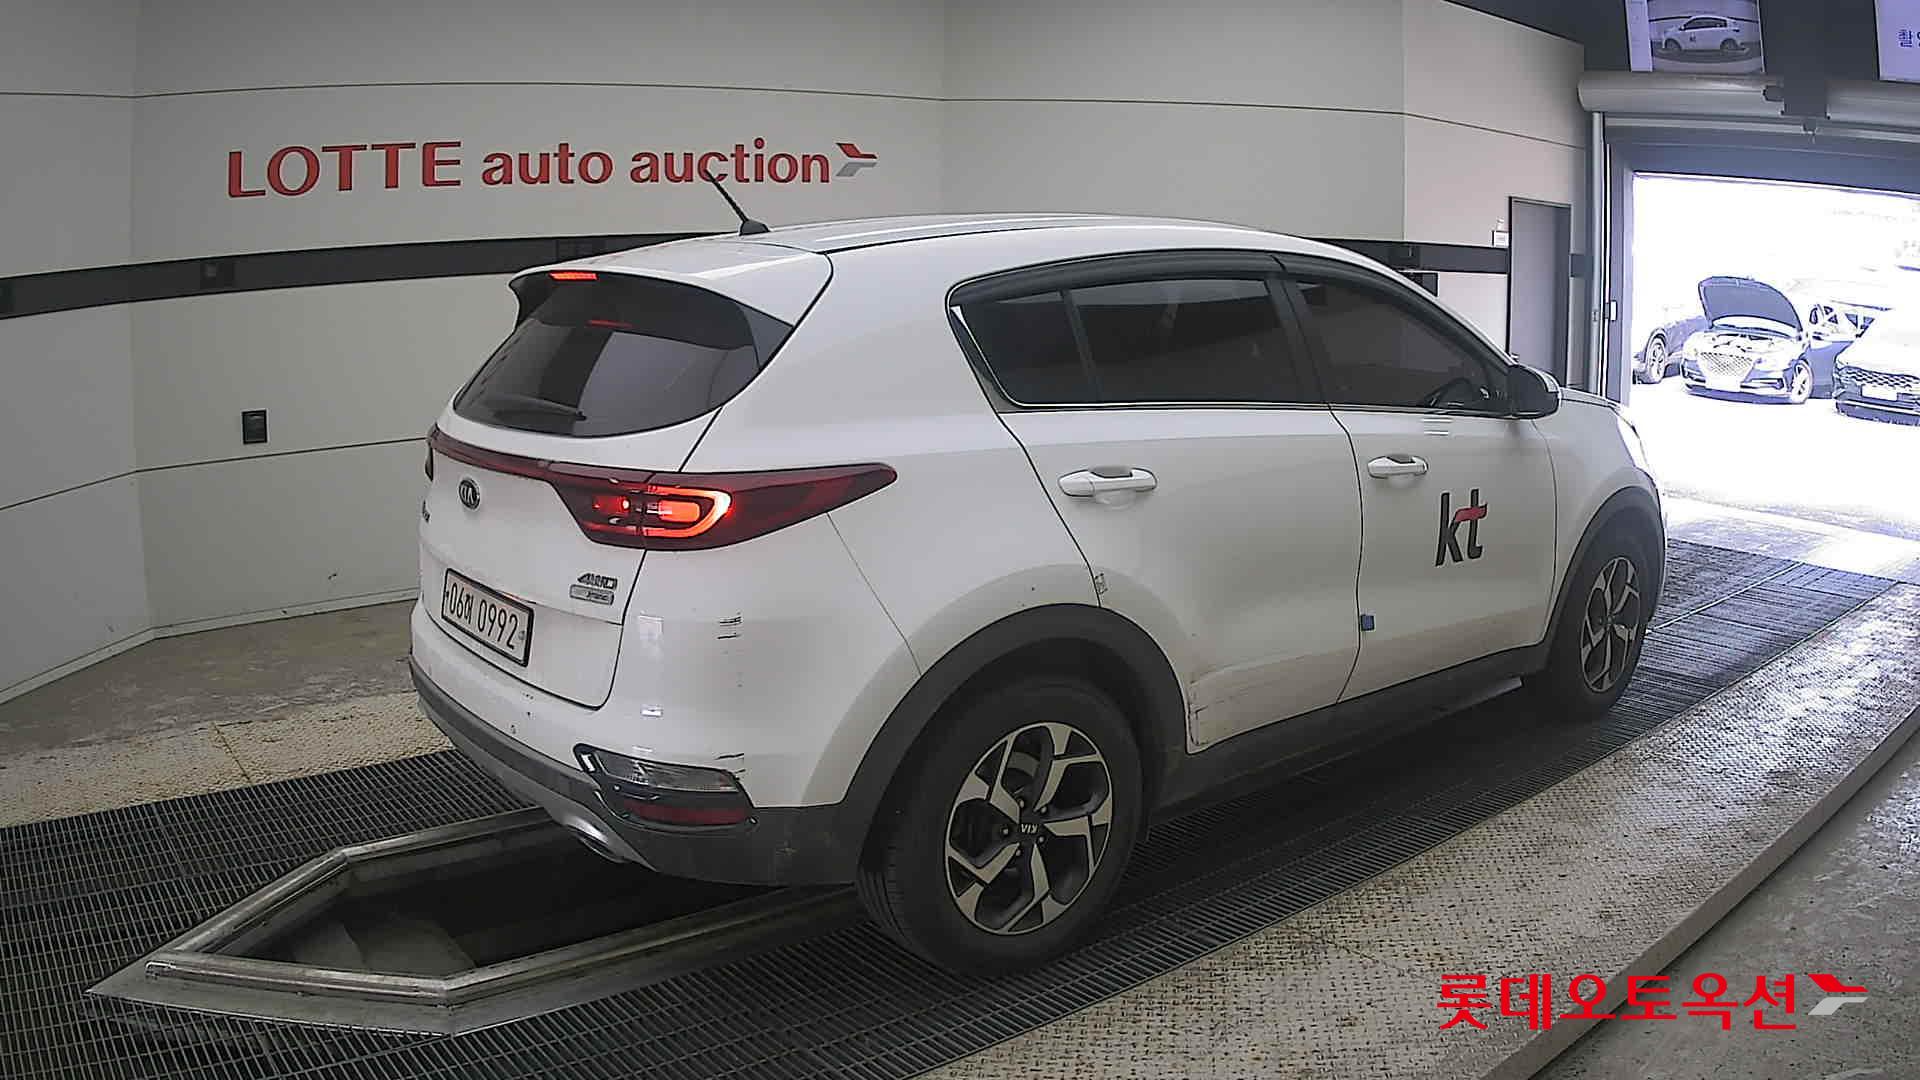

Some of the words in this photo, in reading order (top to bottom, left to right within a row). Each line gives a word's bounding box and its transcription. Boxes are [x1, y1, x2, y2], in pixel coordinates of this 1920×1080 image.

[228, 140, 461, 199] LOTTE
[481, 142, 613, 186] auto
[630, 138, 831, 184] auction
[1435, 489, 1488, 566] kt
[478, 599, 518, 650] 0992
